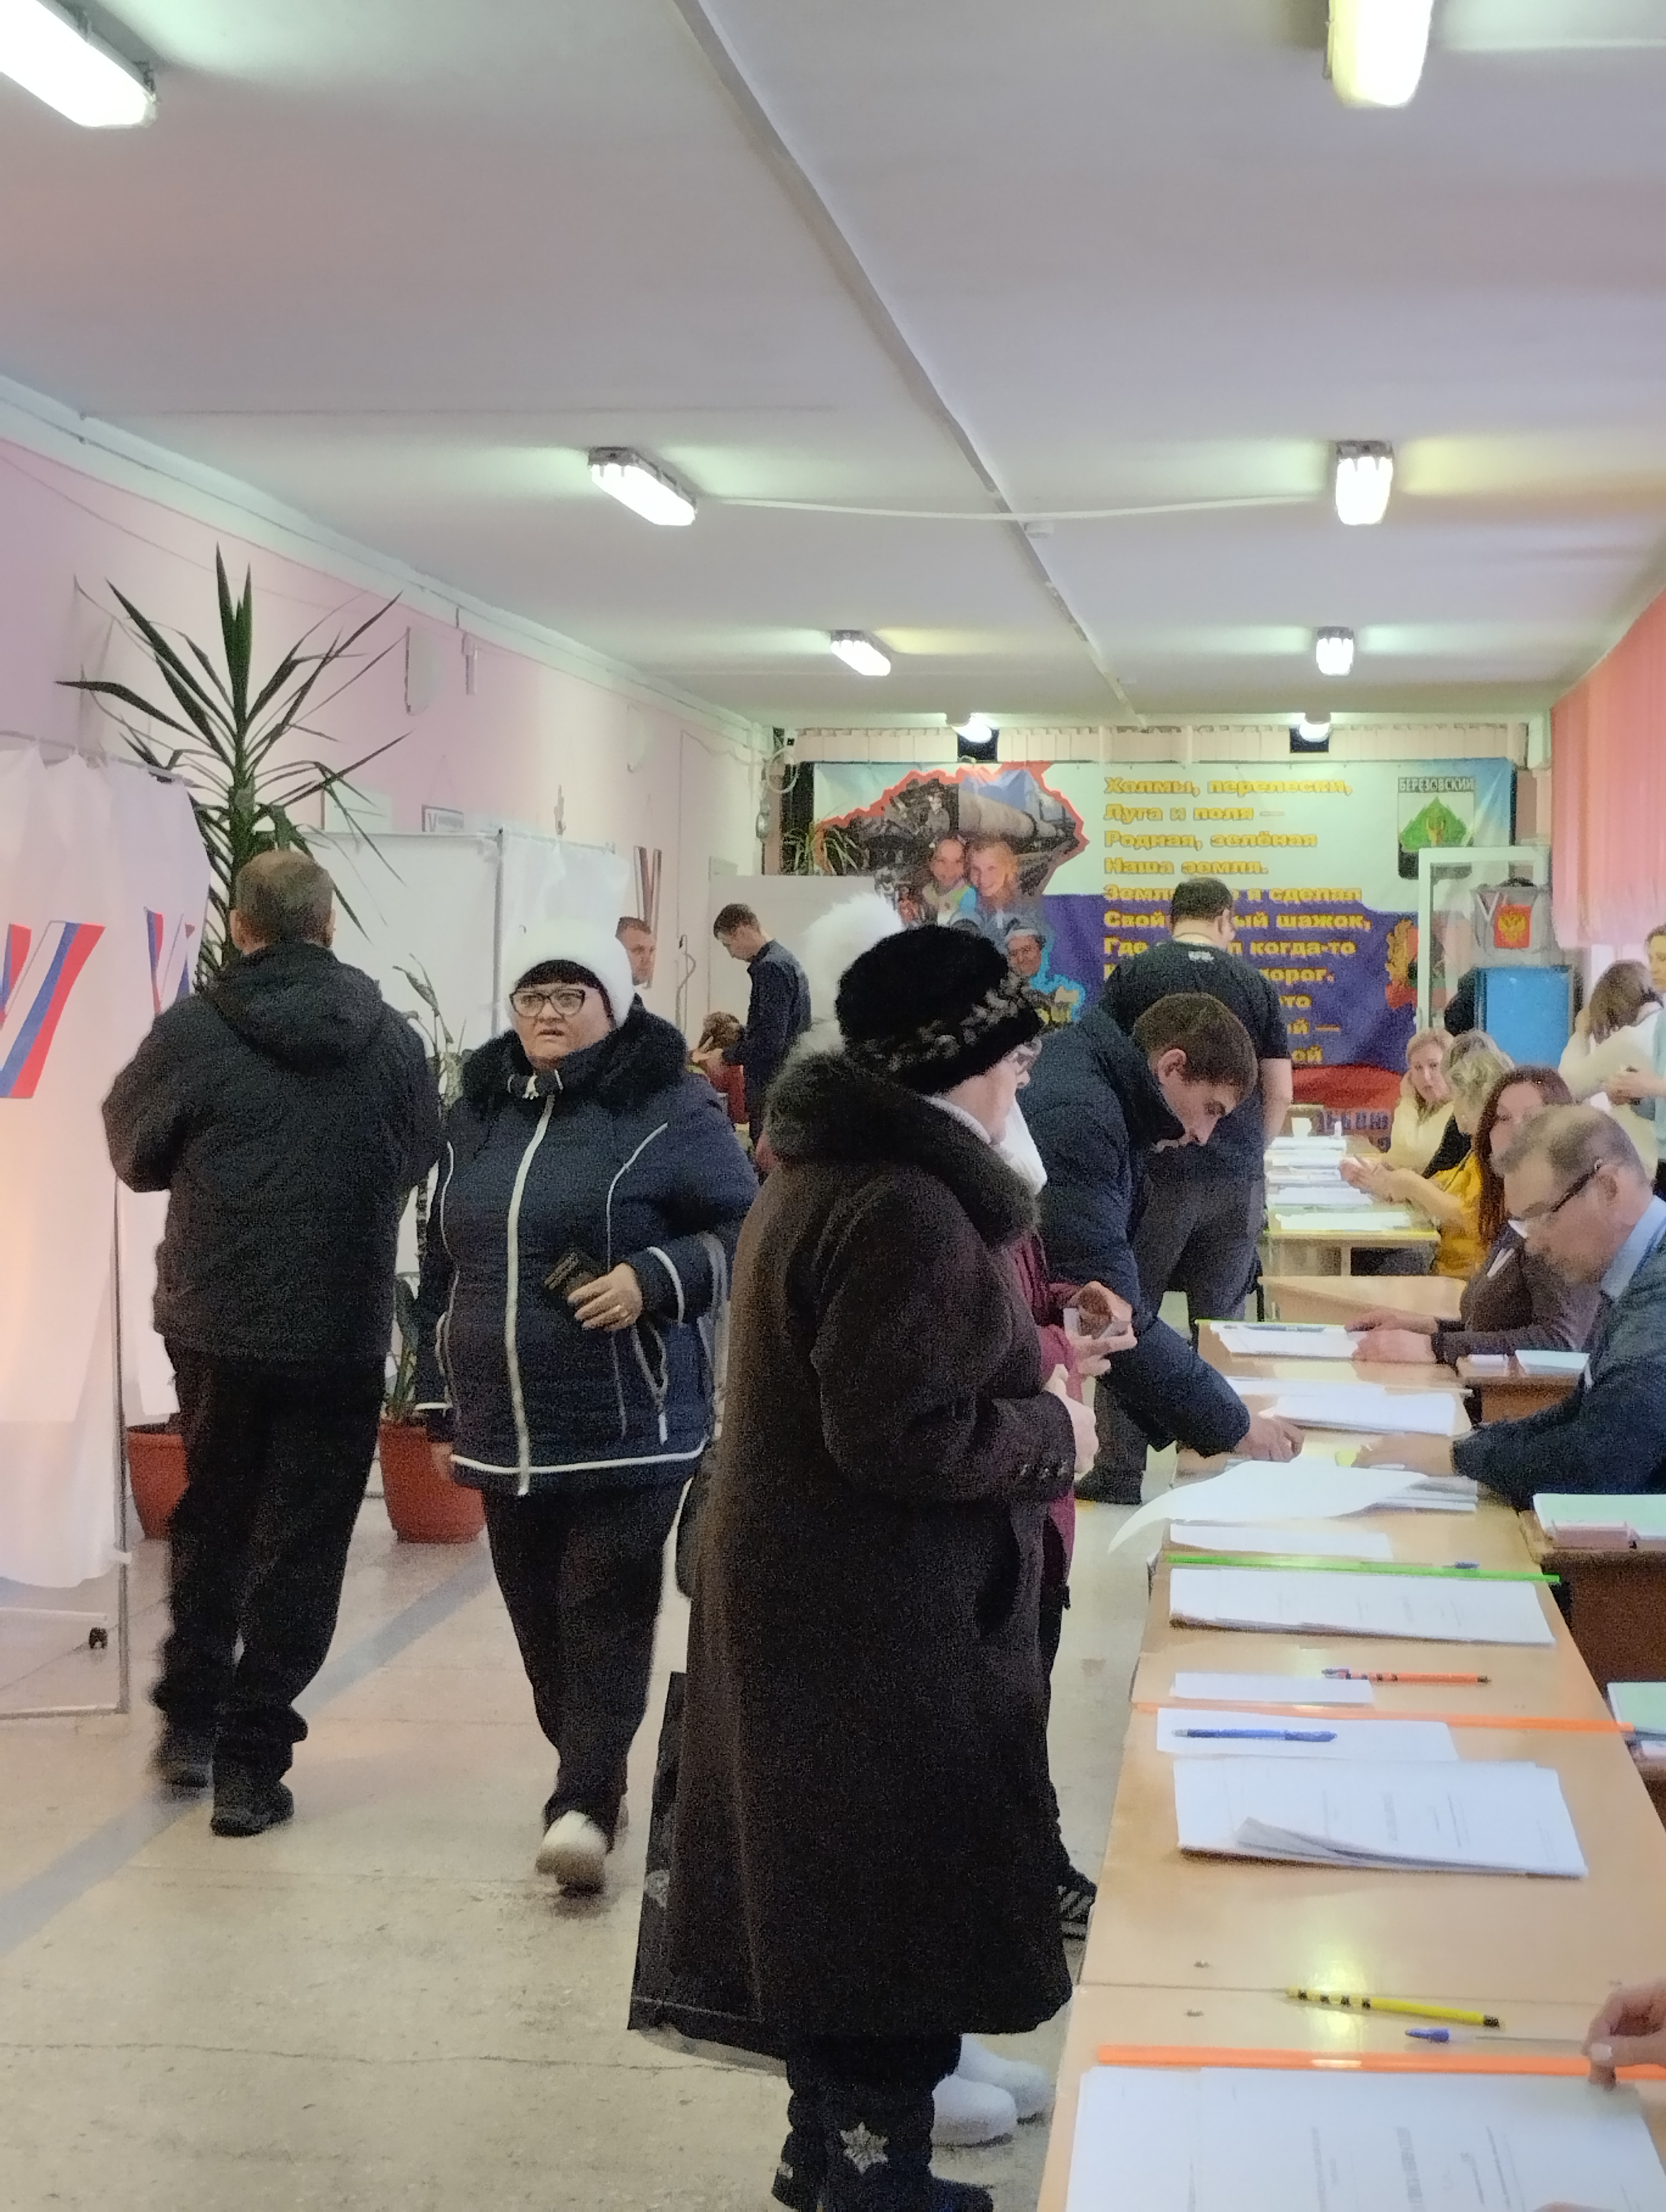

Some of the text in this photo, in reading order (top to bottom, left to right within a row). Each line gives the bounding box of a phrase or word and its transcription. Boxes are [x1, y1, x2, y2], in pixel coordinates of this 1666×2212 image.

[1104, 777, 1353, 798] Холмы, перелески,
[1103, 803, 1163, 824] Луга
[1170, 807, 1186, 821] и
[1193, 807, 1254, 821] поля
[1104, 830, 1318, 851] Родная, зелёная
[1104, 857, 1175, 874] Наша
[1103, 884, 1175, 902] Земл
[1269, 888, 1362, 904] сделал
[1103, 909, 1165, 928] Свой
[1276, 913, 1372, 931] шажок,
[1103, 935, 1150, 956] Где
[1250, 940, 1357, 958] когда-то
